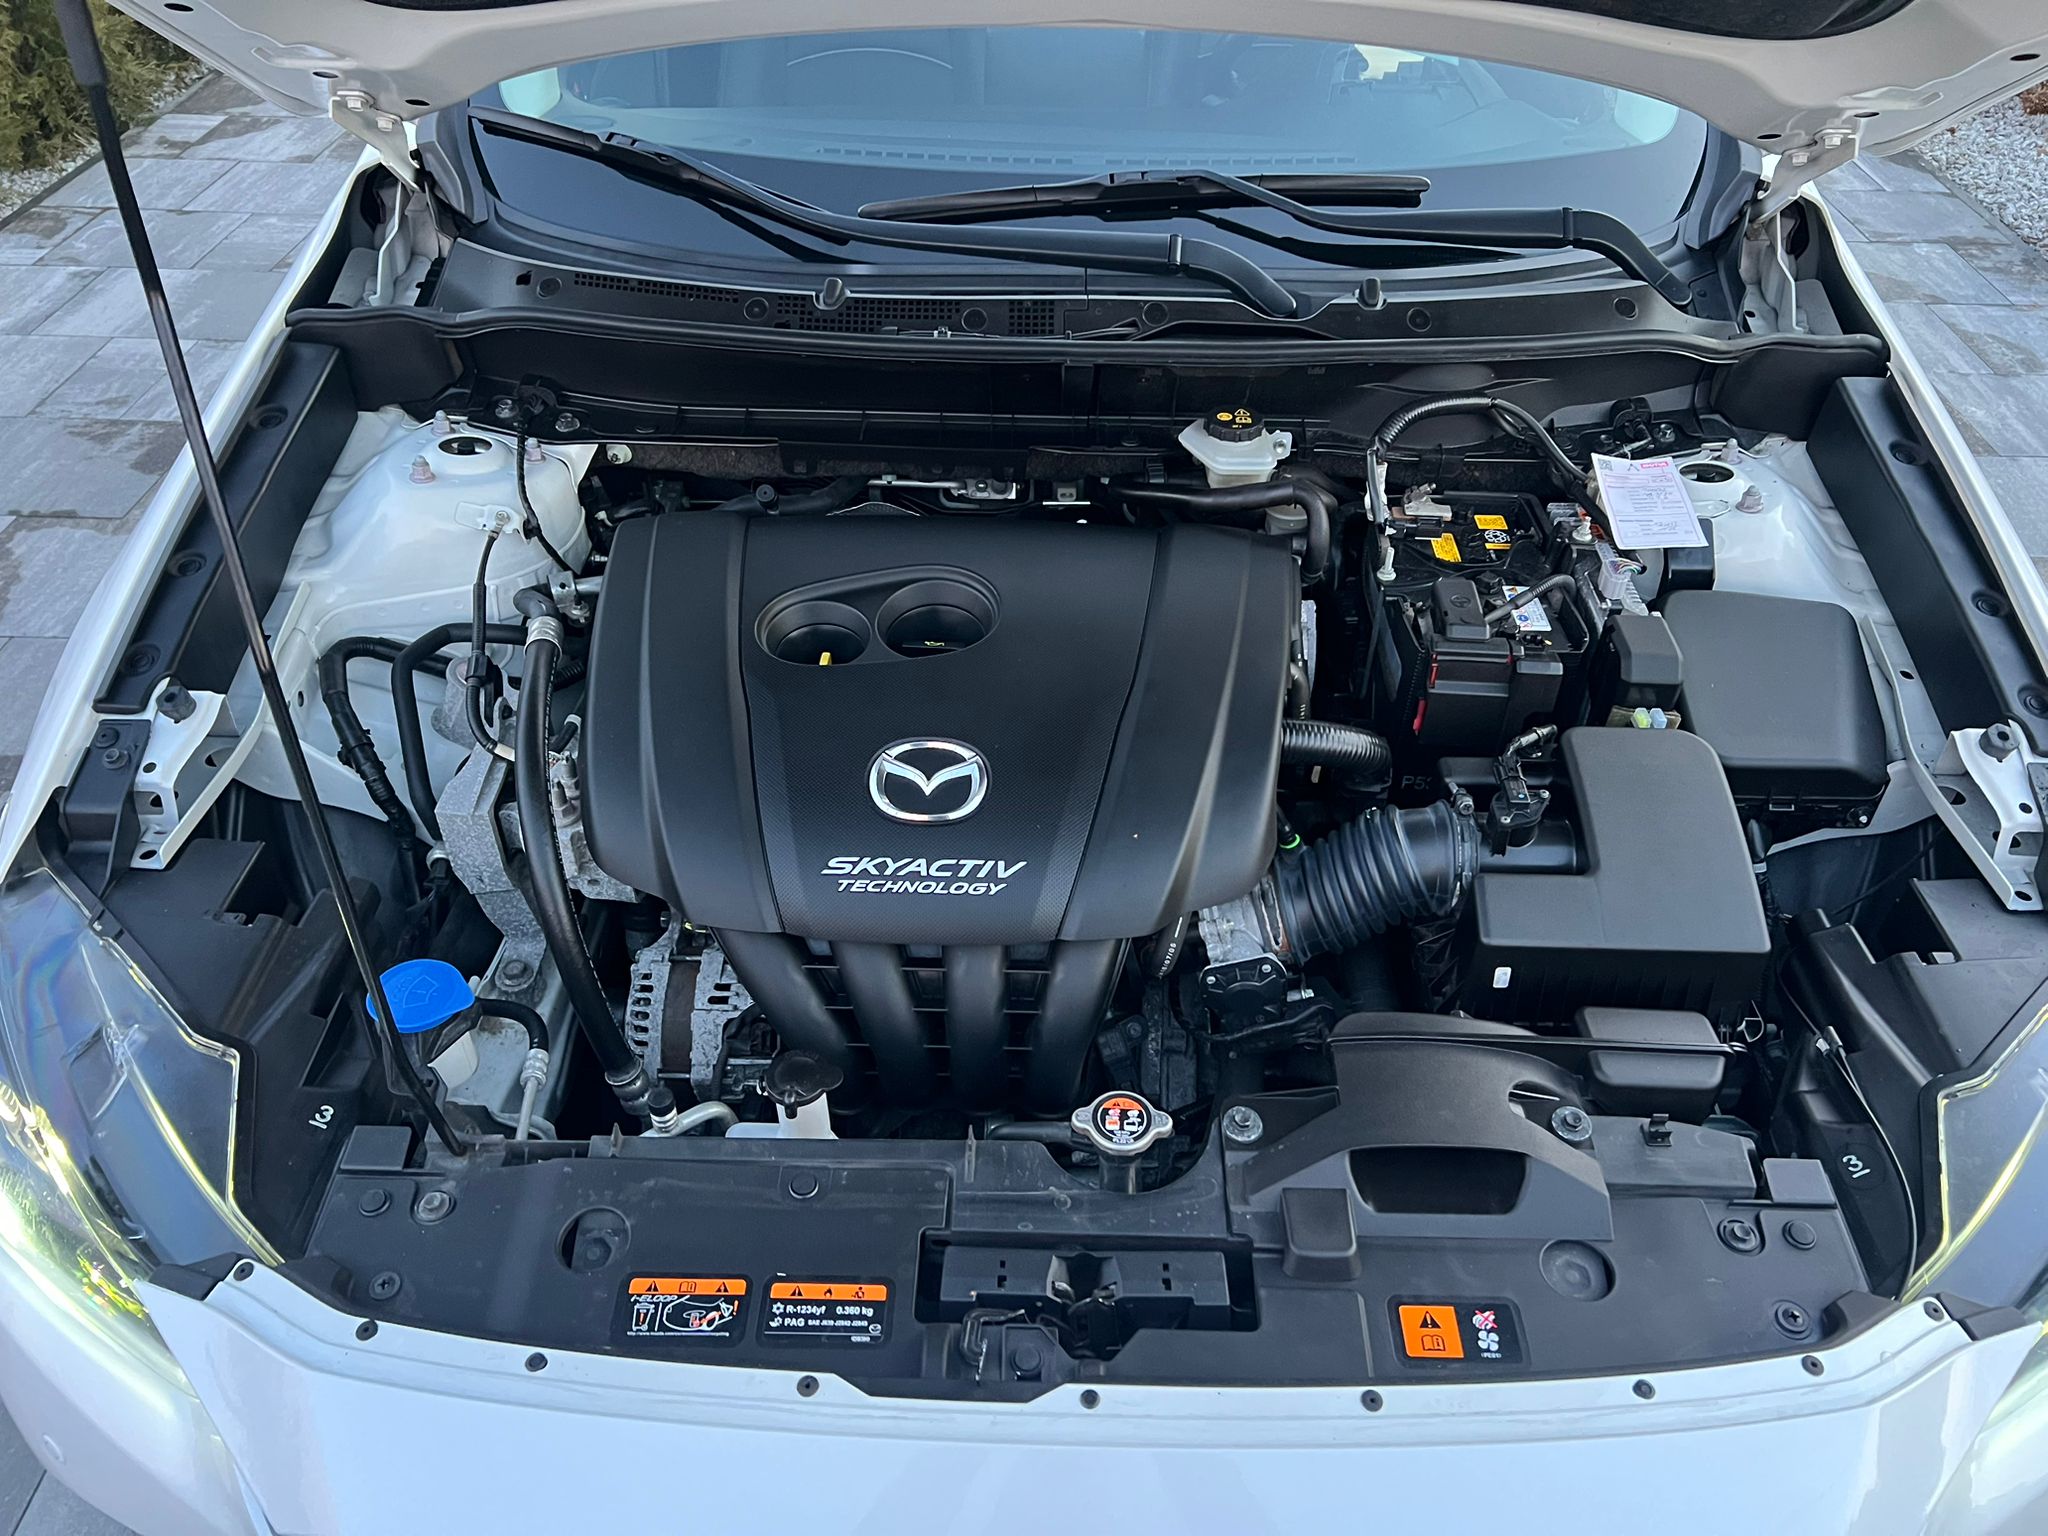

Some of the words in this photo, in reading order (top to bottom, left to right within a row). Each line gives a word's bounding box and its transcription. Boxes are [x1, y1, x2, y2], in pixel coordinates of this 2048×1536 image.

[820, 856, 1028, 879] SKYACTIV
[837, 879, 1008, 895] TECHNOLOGY
[786, 1304, 826, 1315] R-1234yf
[862, 1306, 873, 1317] kg
[784, 1318, 805, 1327] PAG
